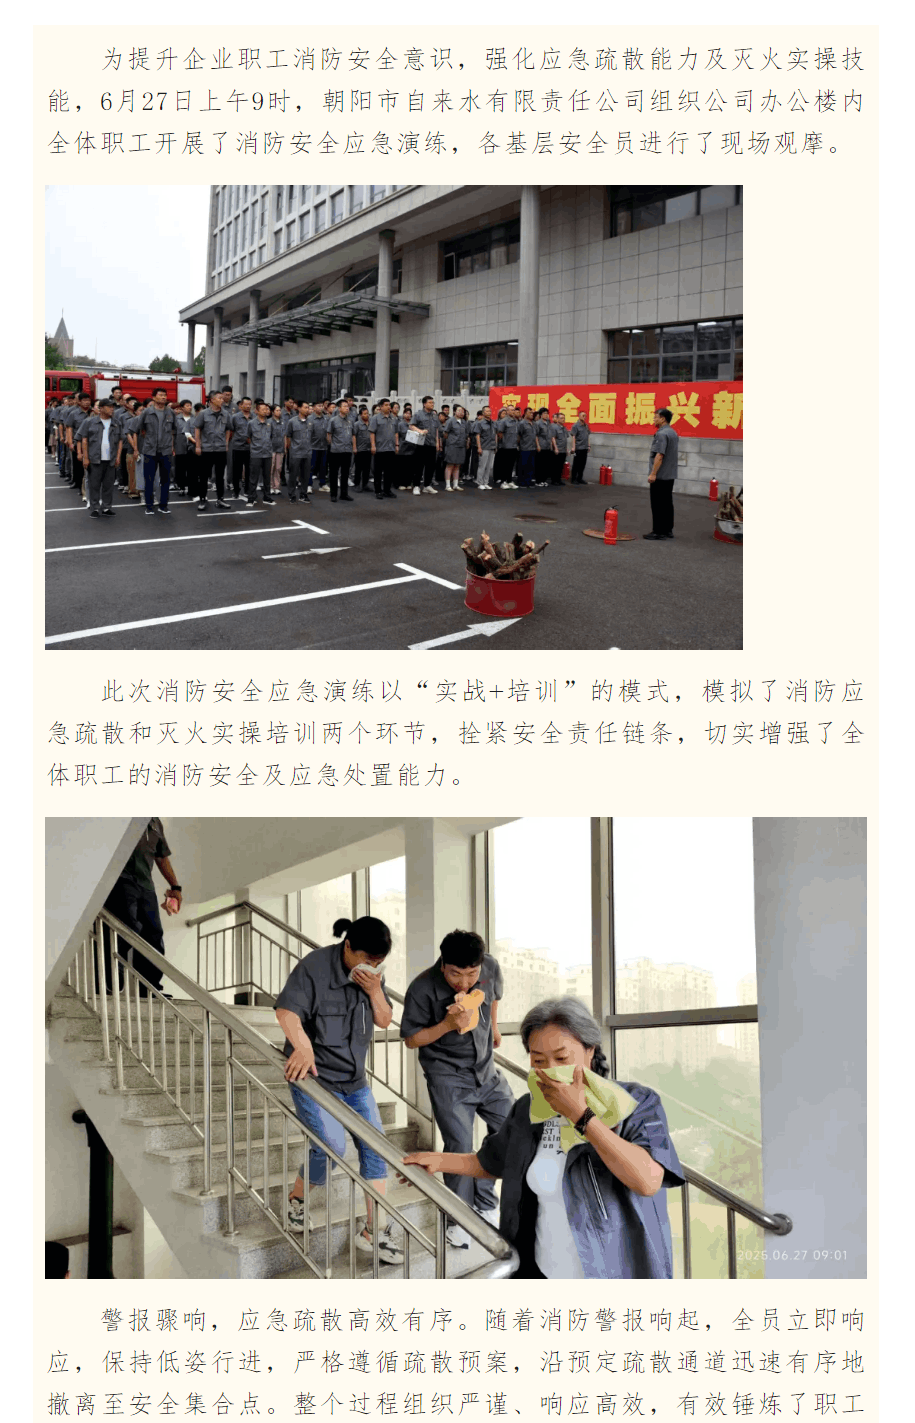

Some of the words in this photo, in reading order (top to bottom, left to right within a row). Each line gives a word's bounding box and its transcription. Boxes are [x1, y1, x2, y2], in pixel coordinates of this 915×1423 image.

[103, 46, 865, 72] 为提升企业职工消防安全意识，强化应急疏散能力及灭火实操技
[48, 88, 862, 114] 能，6月27日上午9时，朝阳市自来水有限责任公司组织公司办公楼内
[47, 130, 837, 156] 全体职工开展了消防安全应急演练，各基层安全员进行了现场观摩。
[48, 720, 864, 746] 急疏散和灭火实操培训两个环节，拴紧安全责任链条，切实增强了全
[47, 762, 460, 788] 体职工的消防安全及应急处置能力。
[100, 1307, 864, 1332] 警报骤响，应急疏散高效有序。随着消防警报响起，全员立即响
[47, 1349, 865, 1374] 应，保持低姿行进，严格遵循疏散预案，沿预定疏散通道迅速有序地
[47, 1391, 865, 1417] 撤离至安全集合点。整个过程组织严谨、响应高效，有效锤炼了职工
